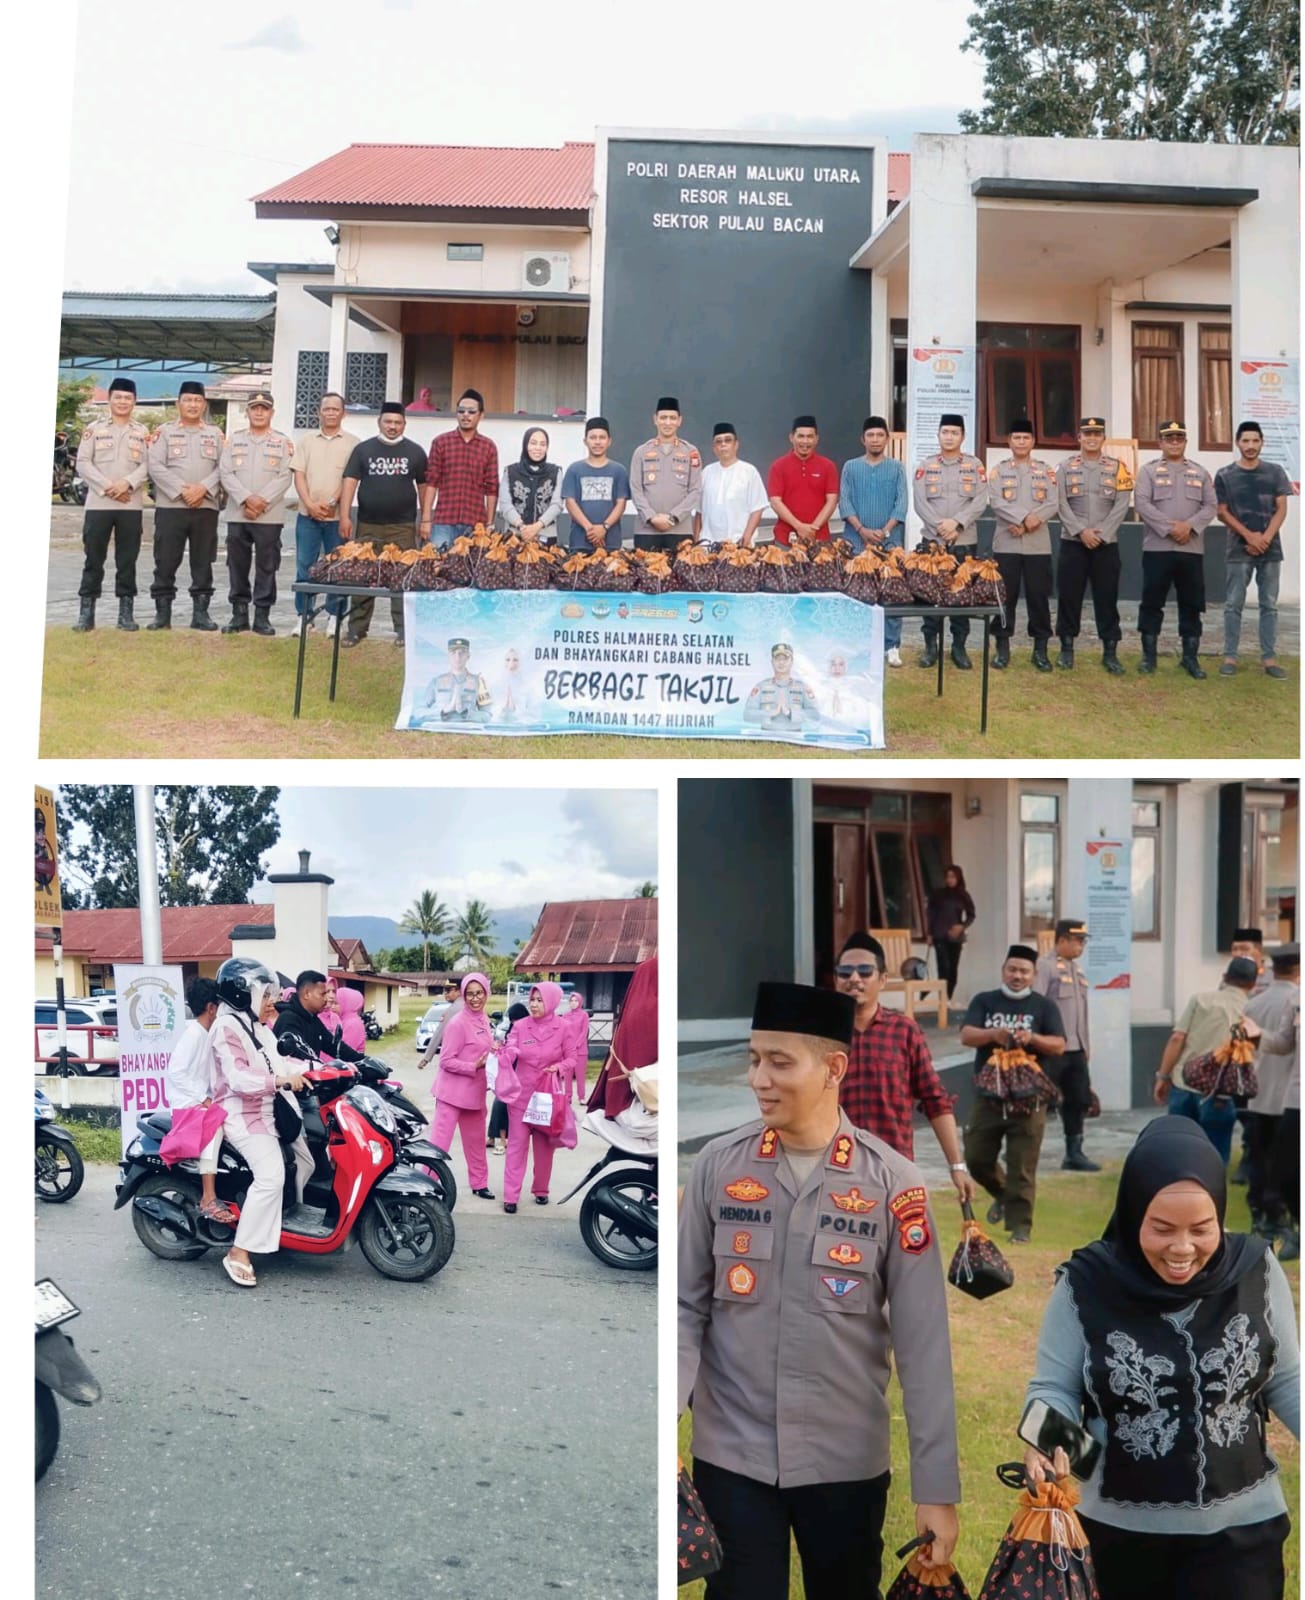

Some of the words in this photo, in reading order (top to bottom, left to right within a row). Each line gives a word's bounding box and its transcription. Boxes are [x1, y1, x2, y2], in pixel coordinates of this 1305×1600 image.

[627, 162, 668, 177] POLRI
[677, 163, 737, 179] DAERAH
[746, 165, 804, 181] MALUKU
[813, 167, 860, 183] UTARA
[680, 189, 728, 204] RESOR
[738, 191, 792, 206] HALSEL
[653, 213, 708, 229] SEKTOR
[719, 216, 764, 231] PULAU
[773, 218, 823, 233] BACAN
[511, 335, 551, 345] PULAU
[553, 630, 600, 644] POLRES
[603, 631, 679, 647] HALMAHERA
[682, 633, 734, 648] SELATAN
[534, 646, 561, 661] DAN
[563, 648, 650, 664] BHAYANGKARI
[654, 650, 703, 665] CABANG
[706, 652, 751, 667] HALSEL
[543, 669, 647, 702] BERBAGI
[655, 673, 741, 705] TAKJIL
[567, 711, 628, 726] RAMADAN
[632, 712, 662, 728] 1447
[665, 713, 715, 729] HIJRIAH
[121, 1052, 172, 1073] BHAYANGK
[122, 1077, 171, 1111] PEDU
[719, 1206, 761, 1223] HENDRA
[820, 1214, 878, 1238] POLRI
